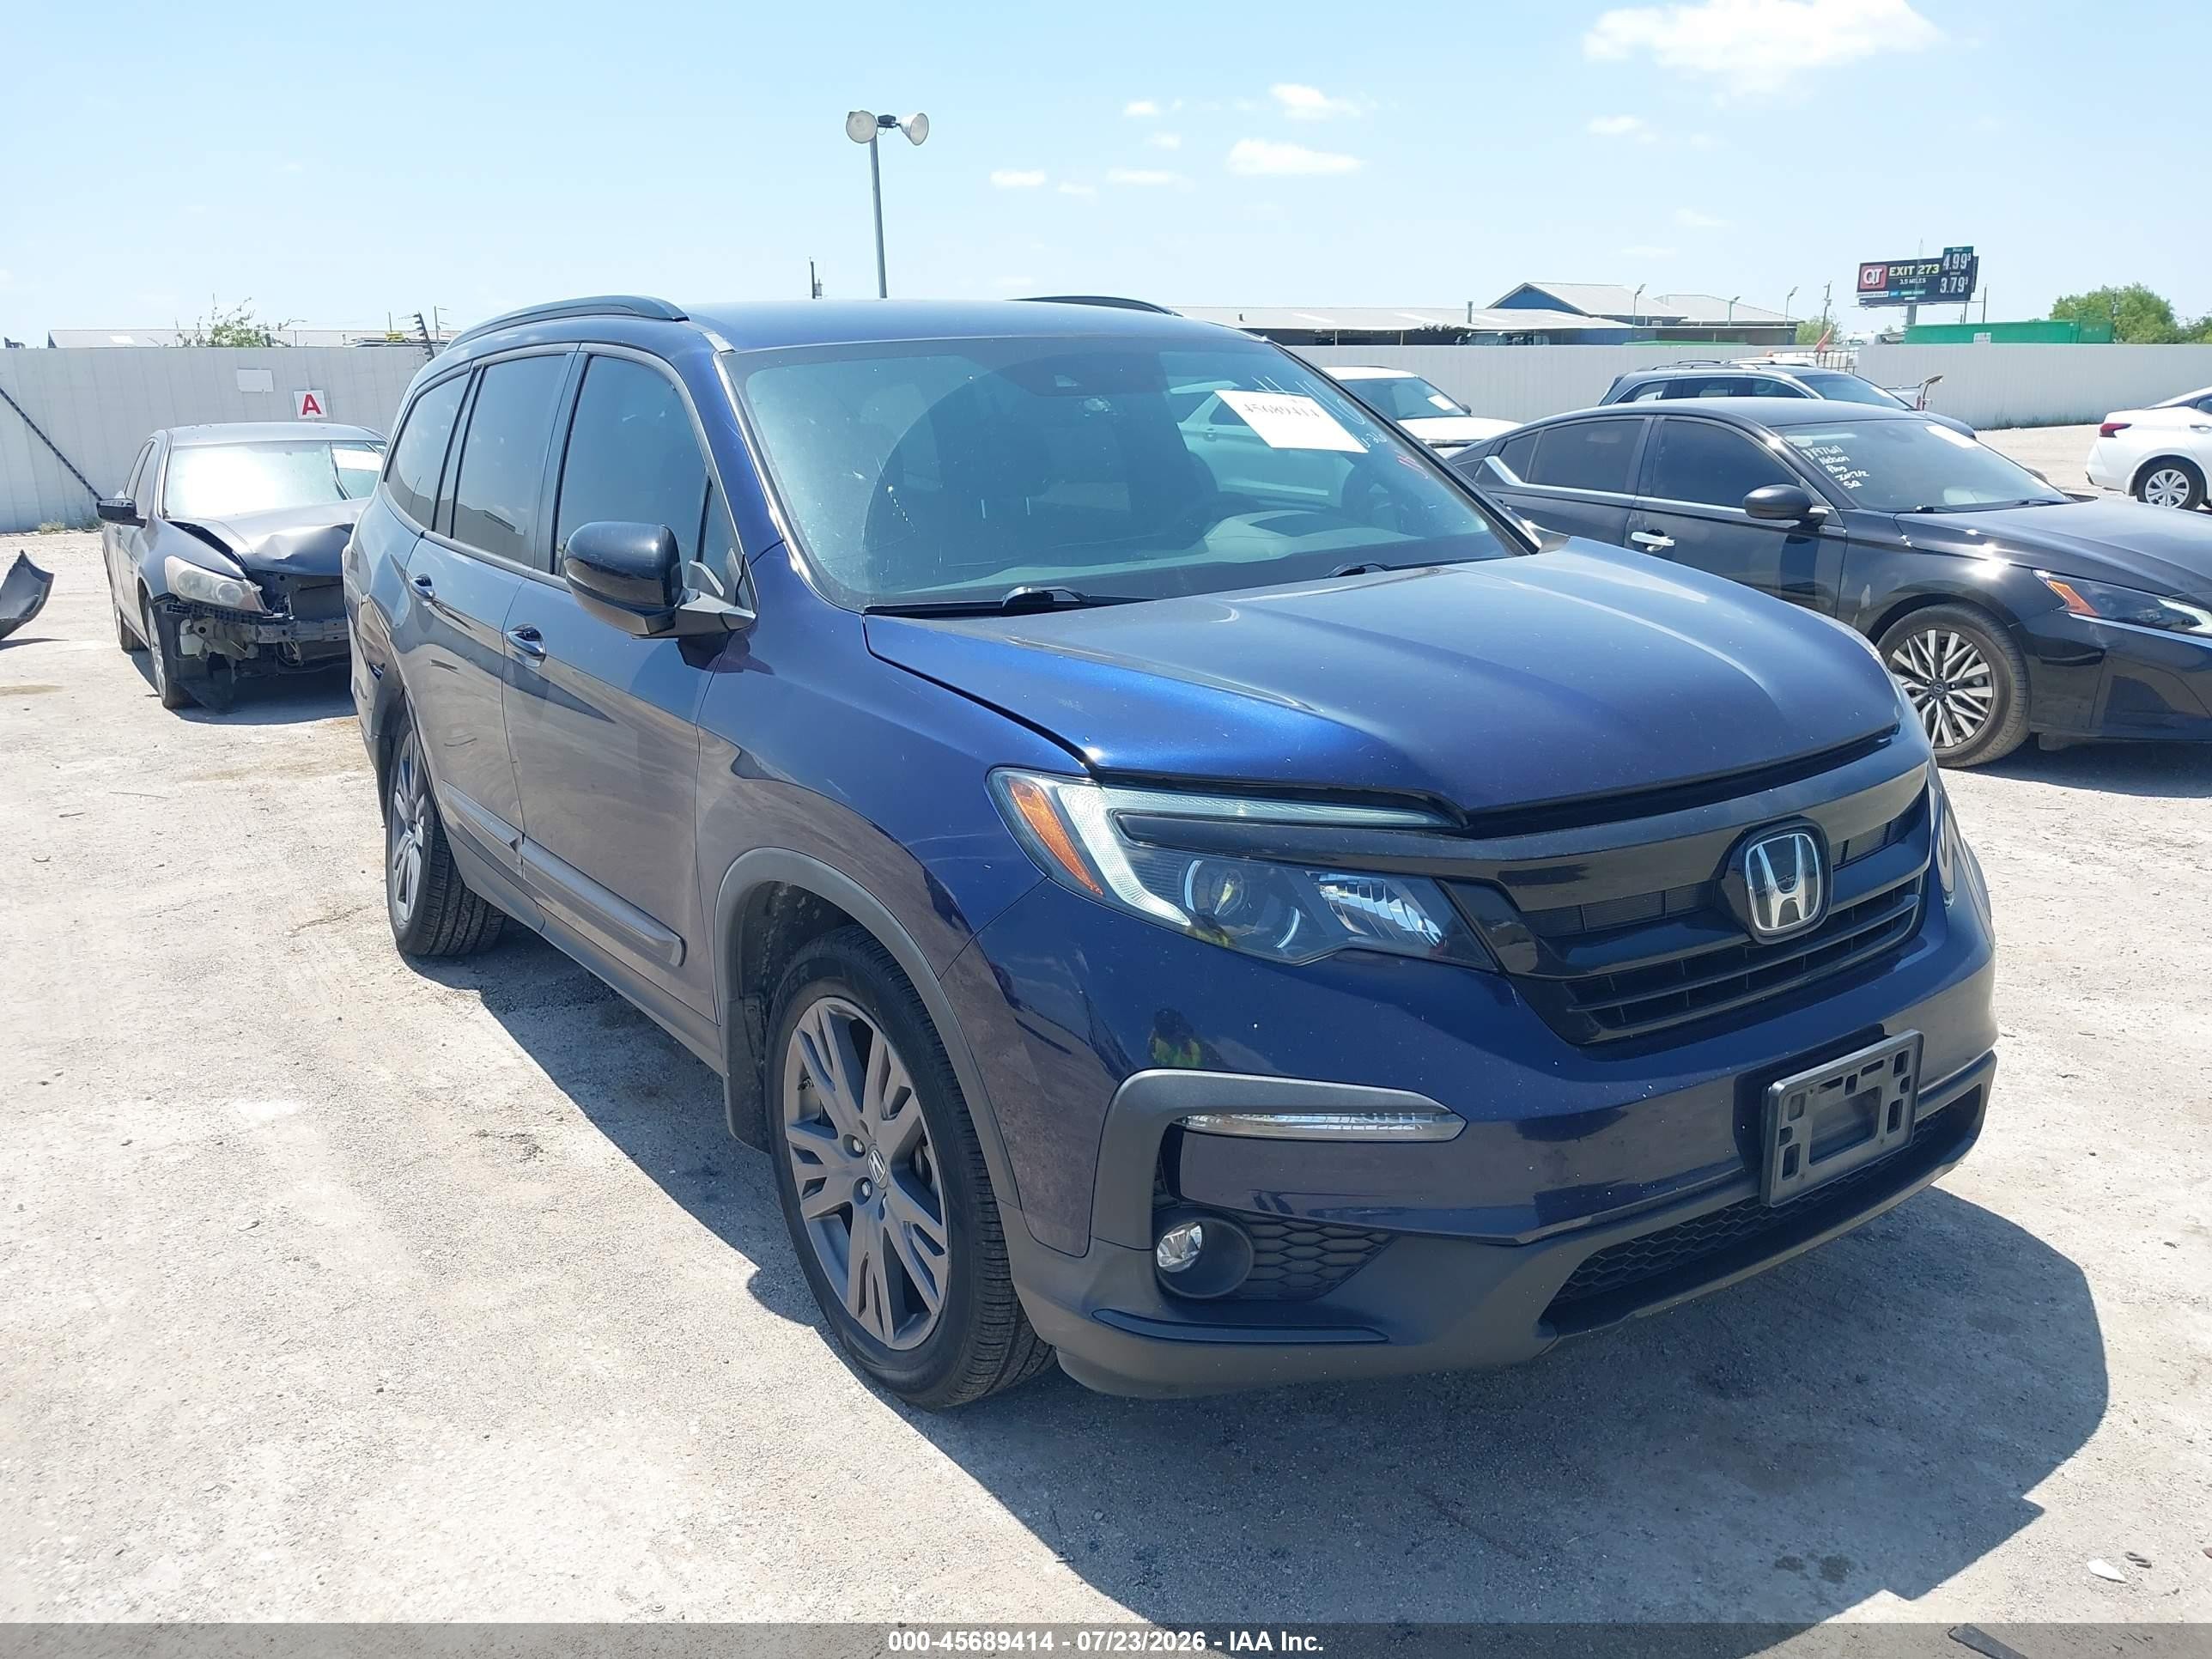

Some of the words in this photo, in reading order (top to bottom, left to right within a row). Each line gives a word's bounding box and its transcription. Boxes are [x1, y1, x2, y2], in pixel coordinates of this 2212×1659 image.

[1863, 268, 1883, 286] QT
[1889, 265, 1916, 276] EXIT
[1917, 264, 1940, 276] 273
[301, 393, 322, 416] A
